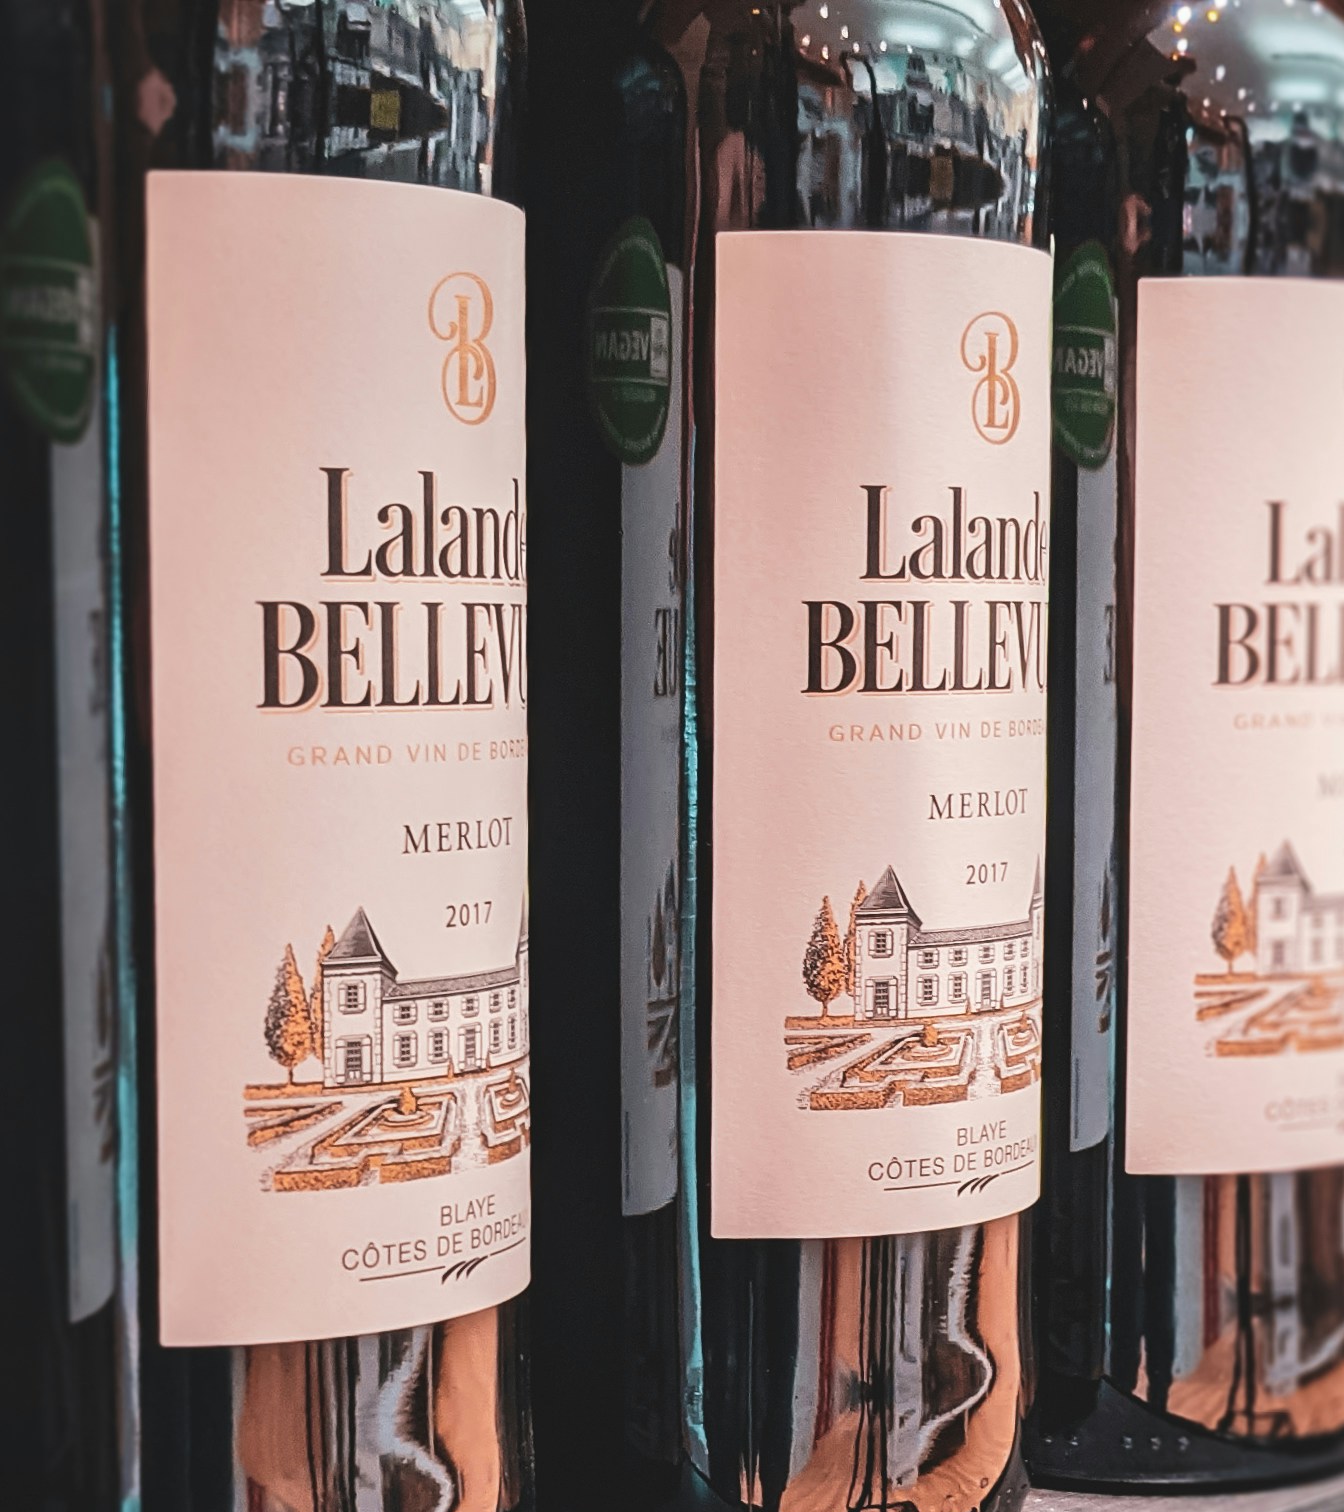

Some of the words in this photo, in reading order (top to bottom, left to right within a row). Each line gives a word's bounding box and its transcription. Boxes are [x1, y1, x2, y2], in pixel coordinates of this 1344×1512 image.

[256, 600, 528, 714] BELLEVU
[801, 599, 1048, 698] BELLEVU
[828, 723, 923, 742] GRAND
[935, 722, 971, 740] VIN
[980, 721, 1002, 739] DE
[287, 744, 393, 767] GRAND
[406, 743, 447, 763] VIN
[458, 741, 482, 762] DE
[928, 788, 1029, 820] MERLOT
[401, 816, 514, 855] MERLOT
[965, 861, 1009, 885] 2017
[446, 900, 493, 928] 2017
[957, 1120, 1007, 1147] BLAYE
[868, 1156, 946, 1182] CÔTES
[953, 1152, 978, 1174] DE
[440, 1194, 497, 1227] BLAYE
[341, 1239, 428, 1271] CÔTES
[437, 1232, 464, 1257] DE
